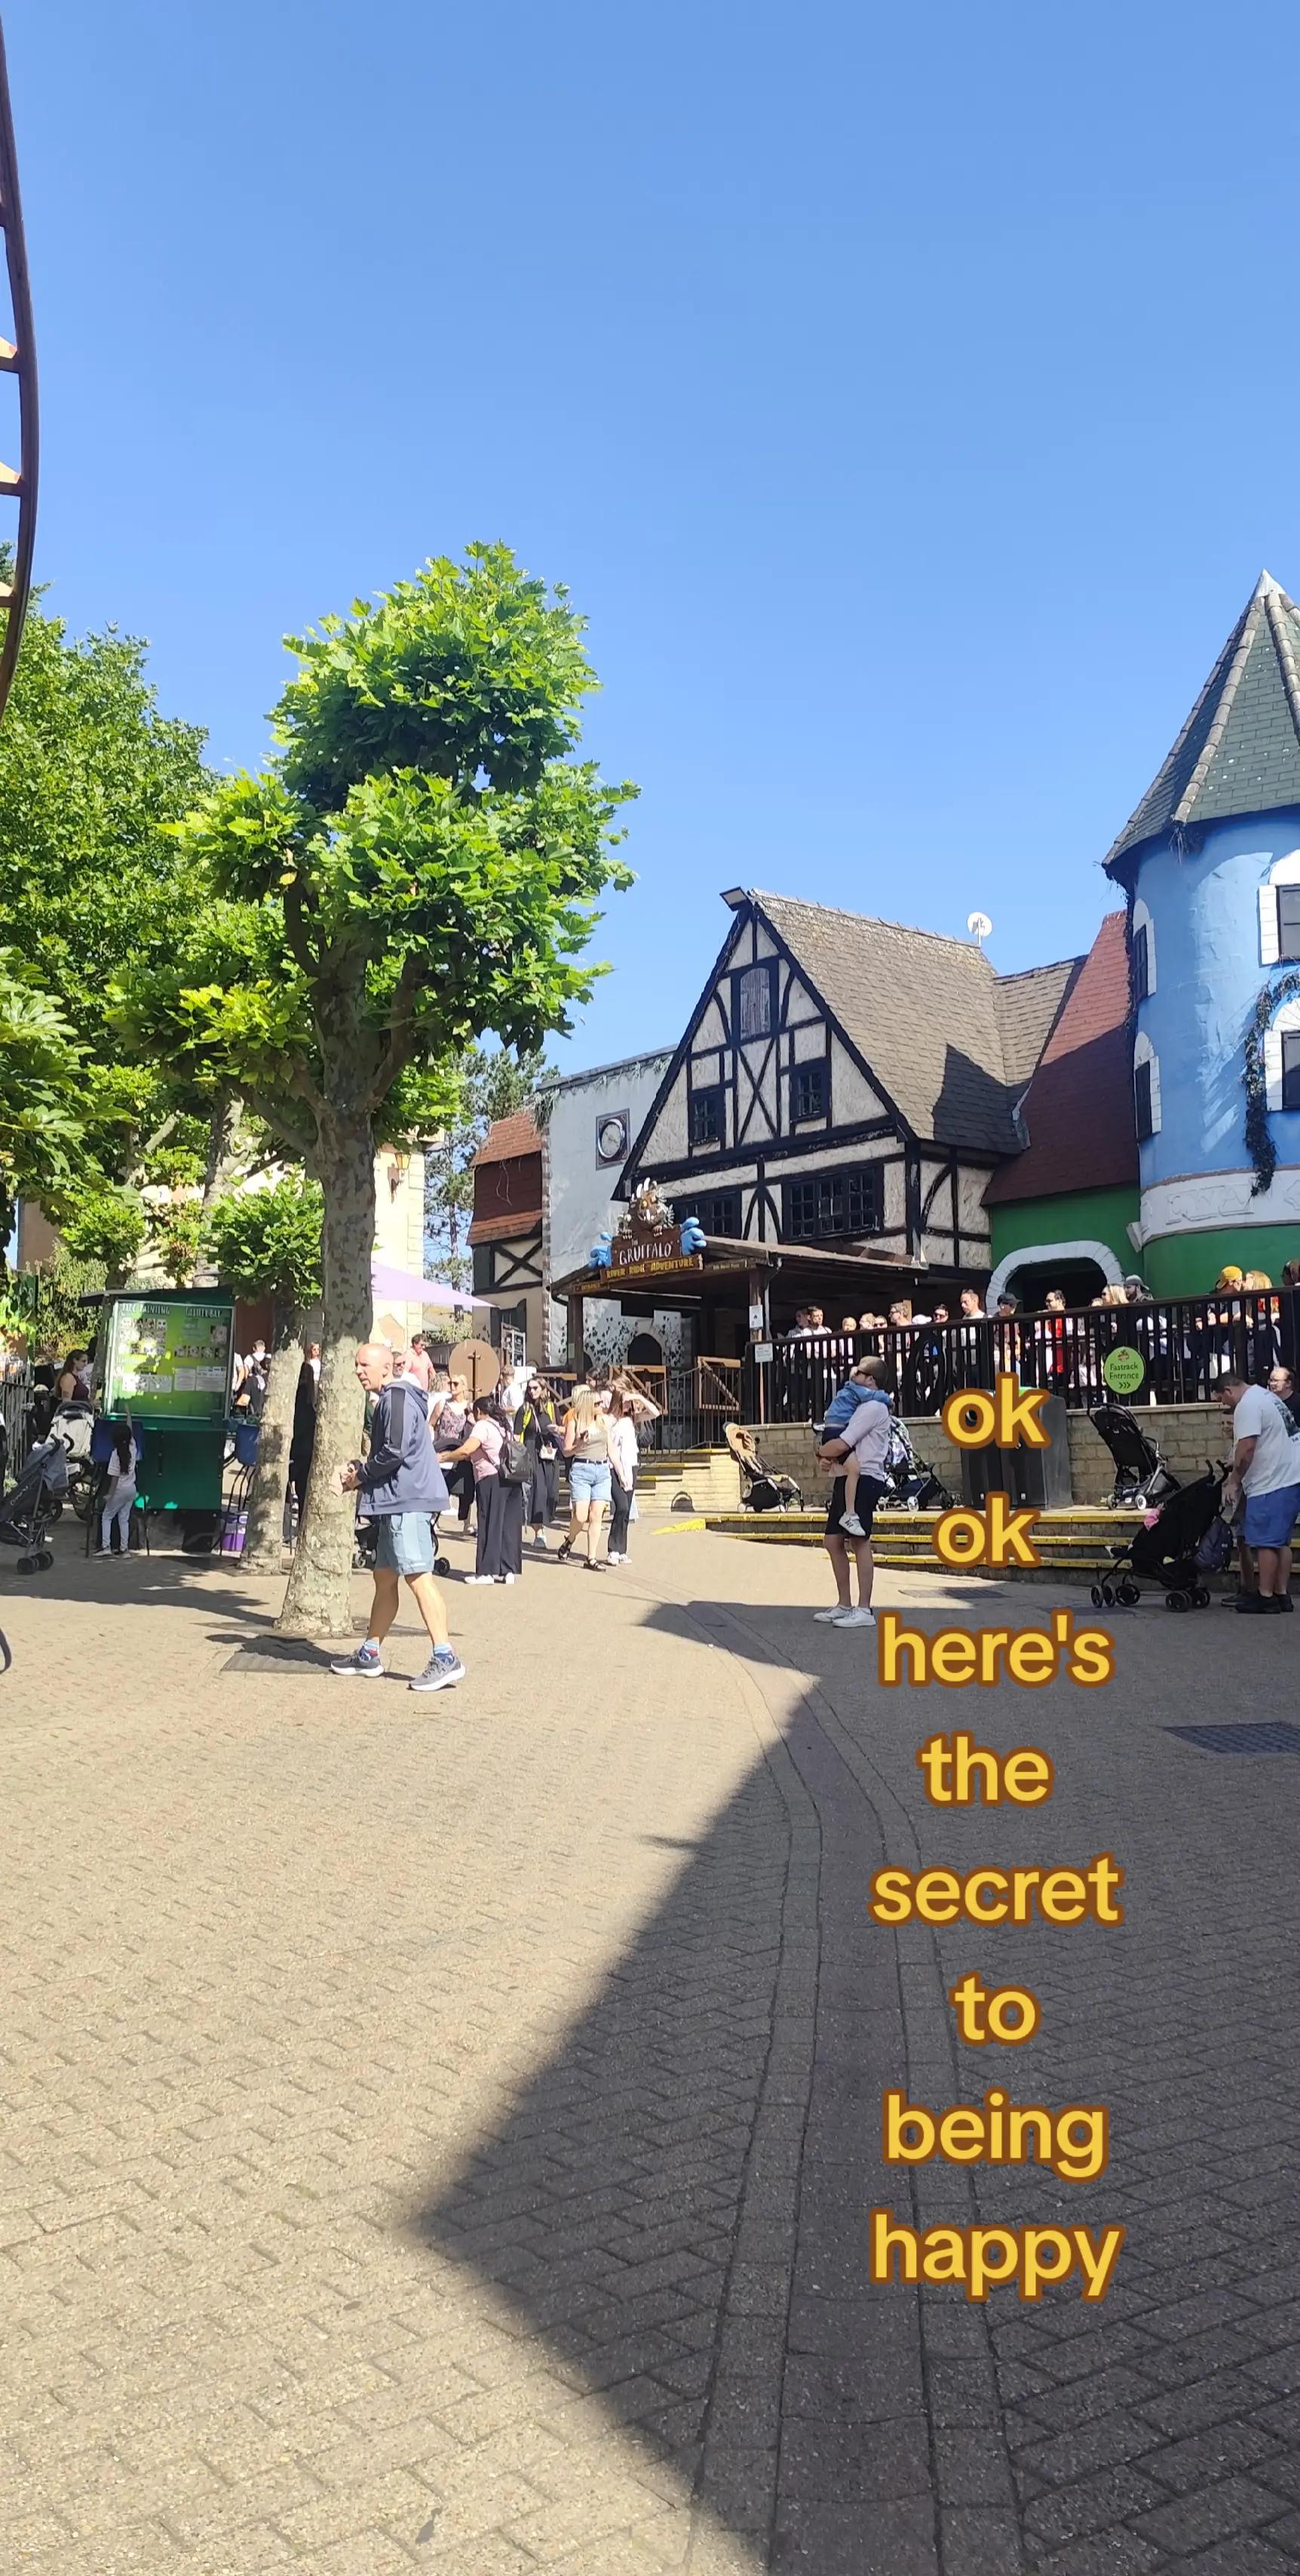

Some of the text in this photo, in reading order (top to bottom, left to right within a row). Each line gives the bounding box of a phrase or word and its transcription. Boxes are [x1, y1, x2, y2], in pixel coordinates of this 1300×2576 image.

[618, 1242, 673, 1265] GRUFFALO
[606, 1268, 626, 1279] RIVER
[650, 1257, 694, 1272] ADVENTURE
[1109, 1361, 1139, 1371] Fastrack
[1109, 1372, 1139, 1380] Entrance
